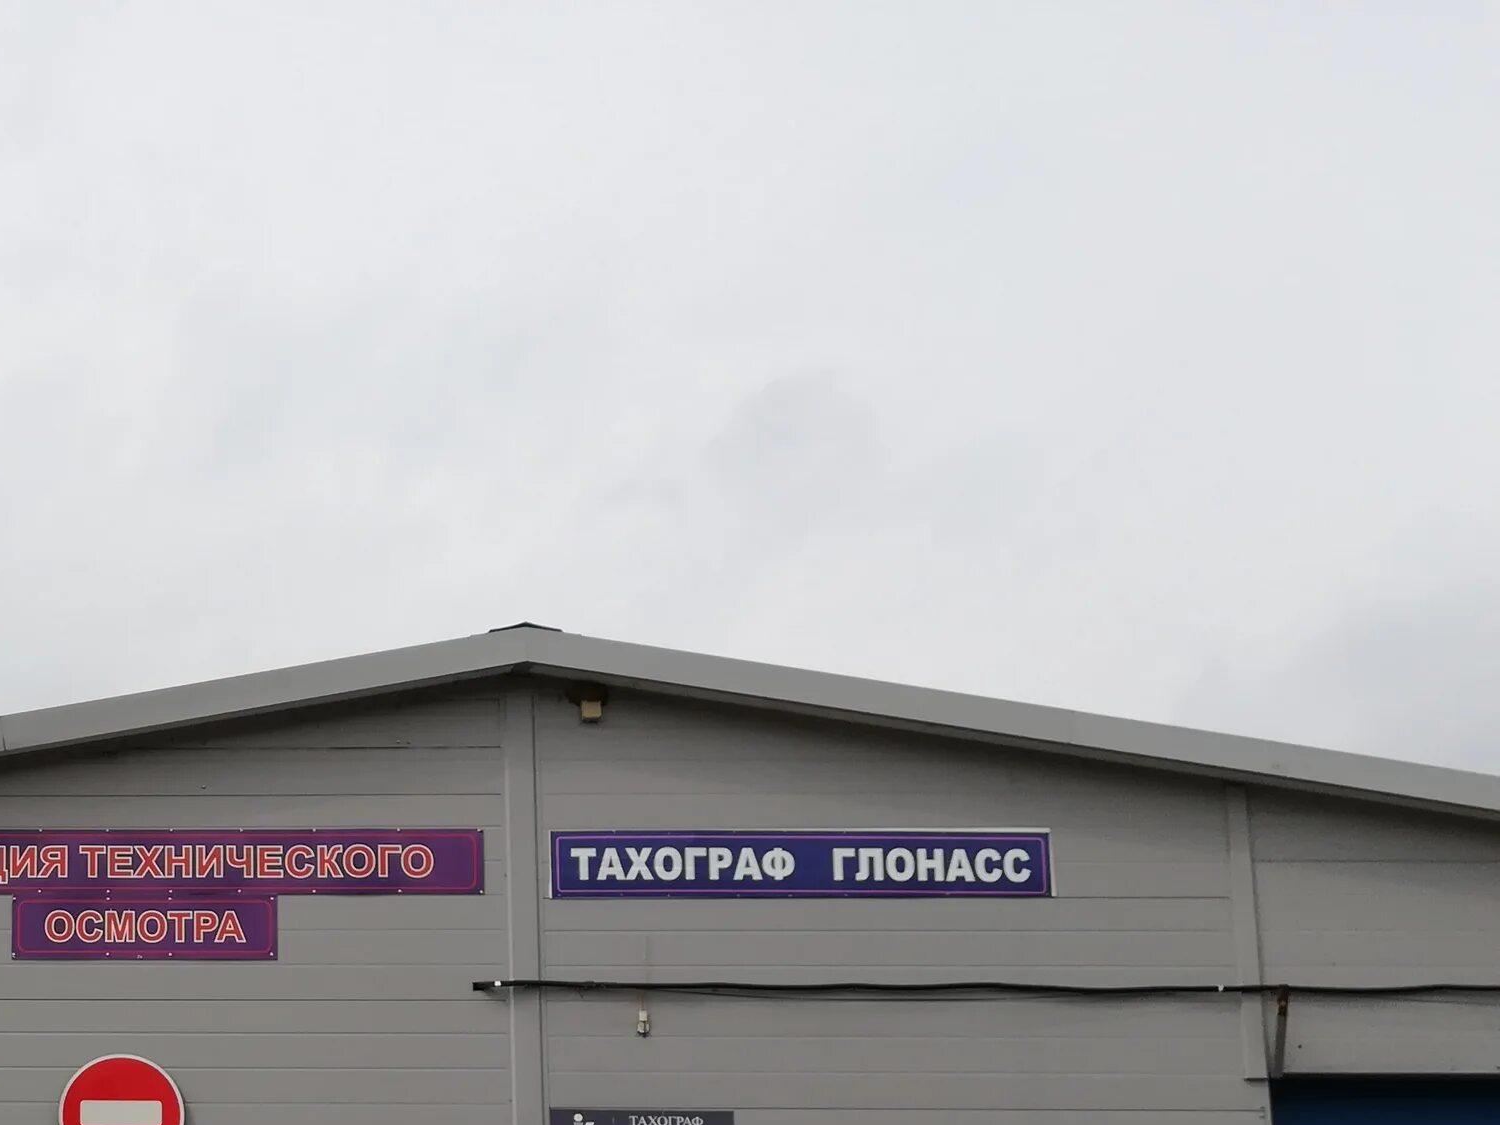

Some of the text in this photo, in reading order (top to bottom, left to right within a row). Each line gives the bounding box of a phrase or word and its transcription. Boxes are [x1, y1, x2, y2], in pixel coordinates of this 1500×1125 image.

[80, 844, 434, 879] ТЕХНИЧЕСКОГО
[570, 846, 1032, 883] ТАХОГРАФ ГЛОНАСС
[44, 909, 247, 943] ОСМОТРА
